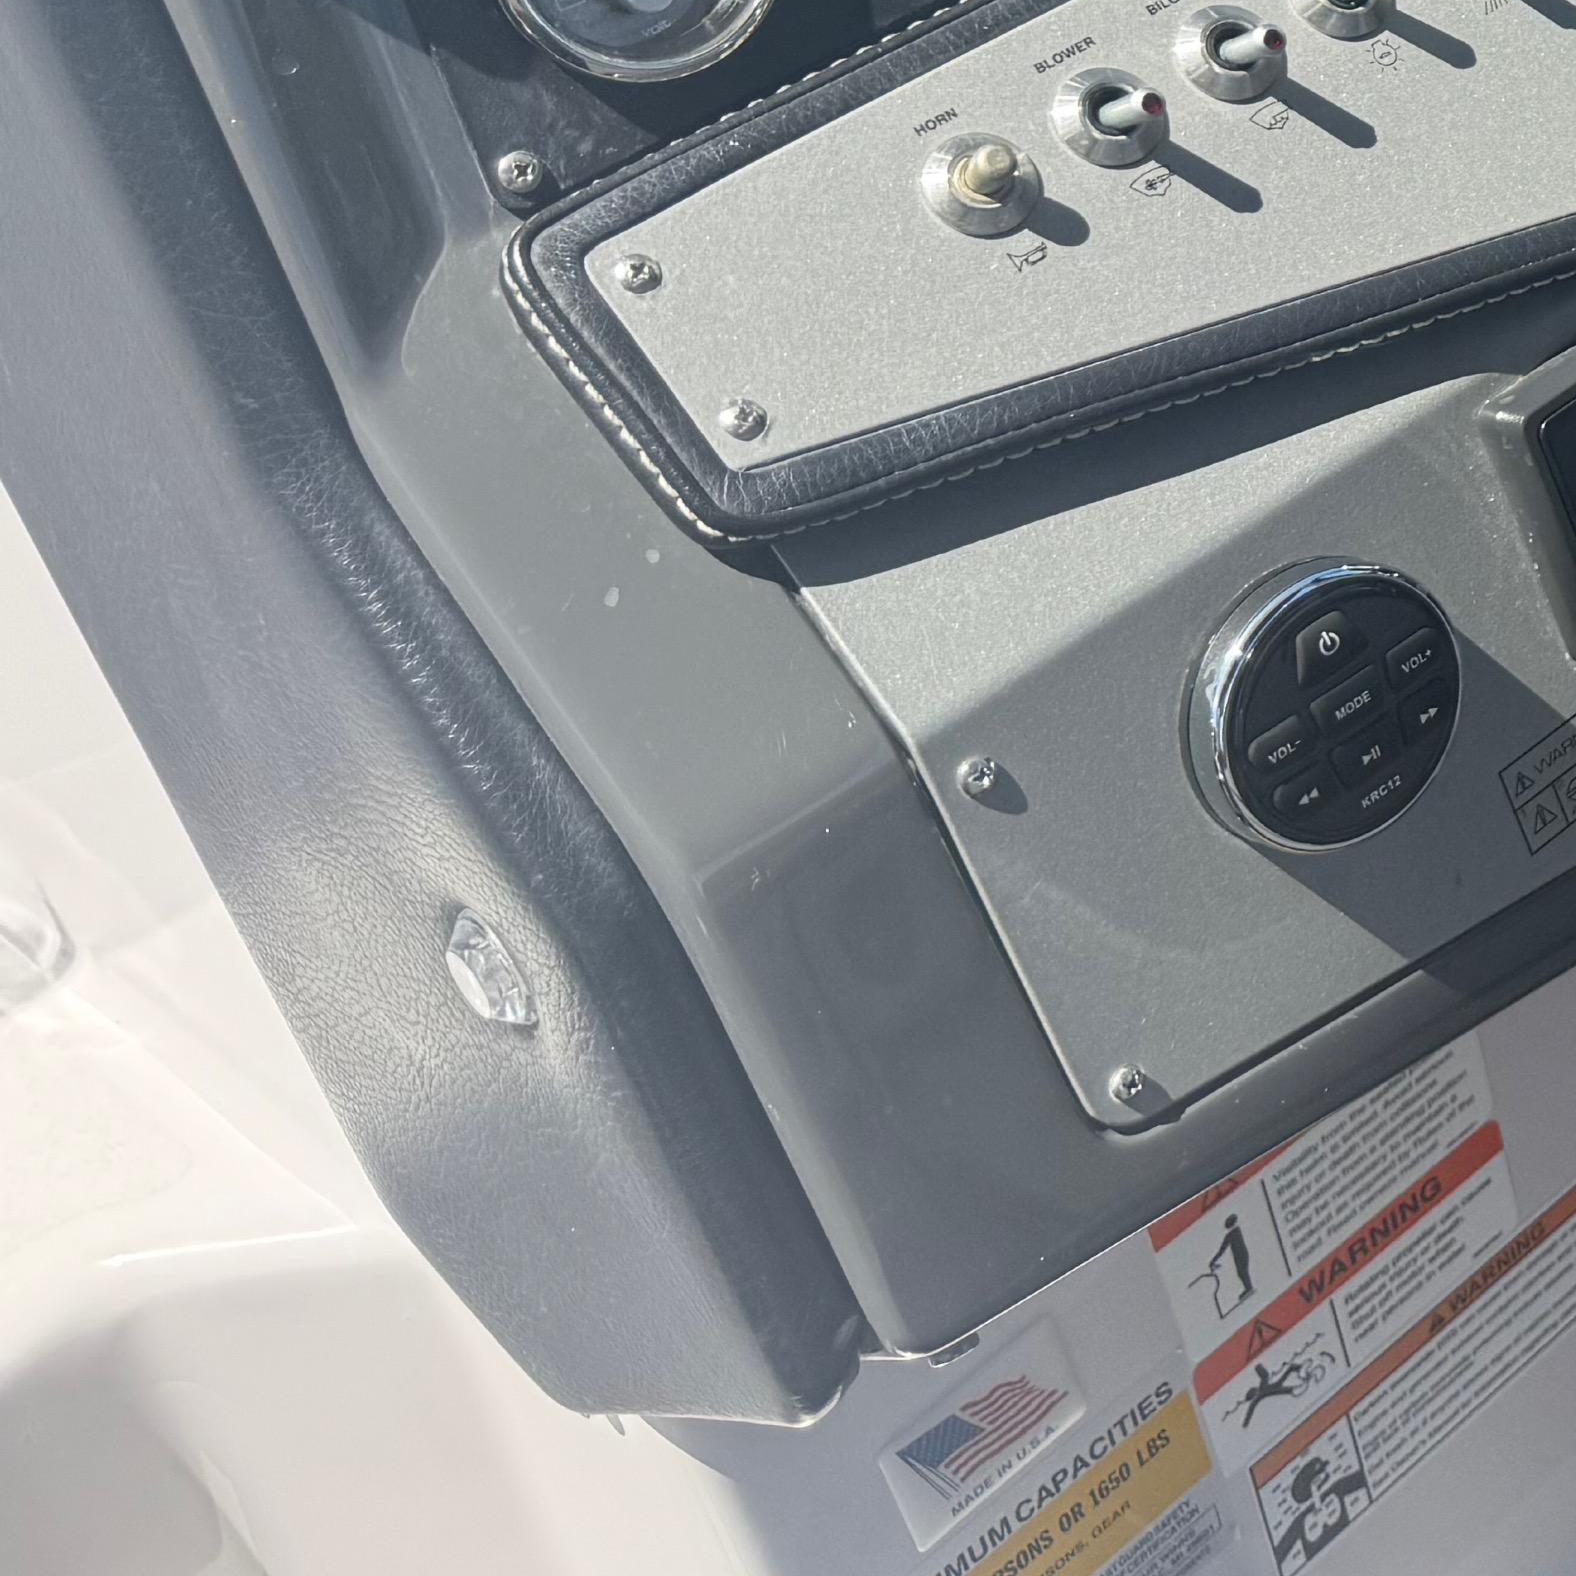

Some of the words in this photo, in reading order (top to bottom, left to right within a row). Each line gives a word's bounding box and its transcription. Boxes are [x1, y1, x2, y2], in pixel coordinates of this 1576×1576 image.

[1033, 36, 1096, 75] BLOWER
[913, 108, 959, 137] HORN
[1401, 649, 1432, 673] VOL+
[1335, 690, 1372, 720] MODE
[1267, 739, 1302, 765] VOL-
[1361, 775, 1401, 808] KRC12
[1299, 1176, 1442, 1304] WARNING
[1449, 1221, 1545, 1312] WARNING
[1015, 1380, 1174, 1523] CAPACITIES
[951, 1476, 994, 1517] MADE
[997, 1459, 1013, 1478] IN
[1058, 1501, 1086, 1533] OR
[1089, 1461, 1131, 1508] 1650
[1138, 1428, 1171, 1469] LBS
[1091, 1499, 1132, 1539] GEAR
